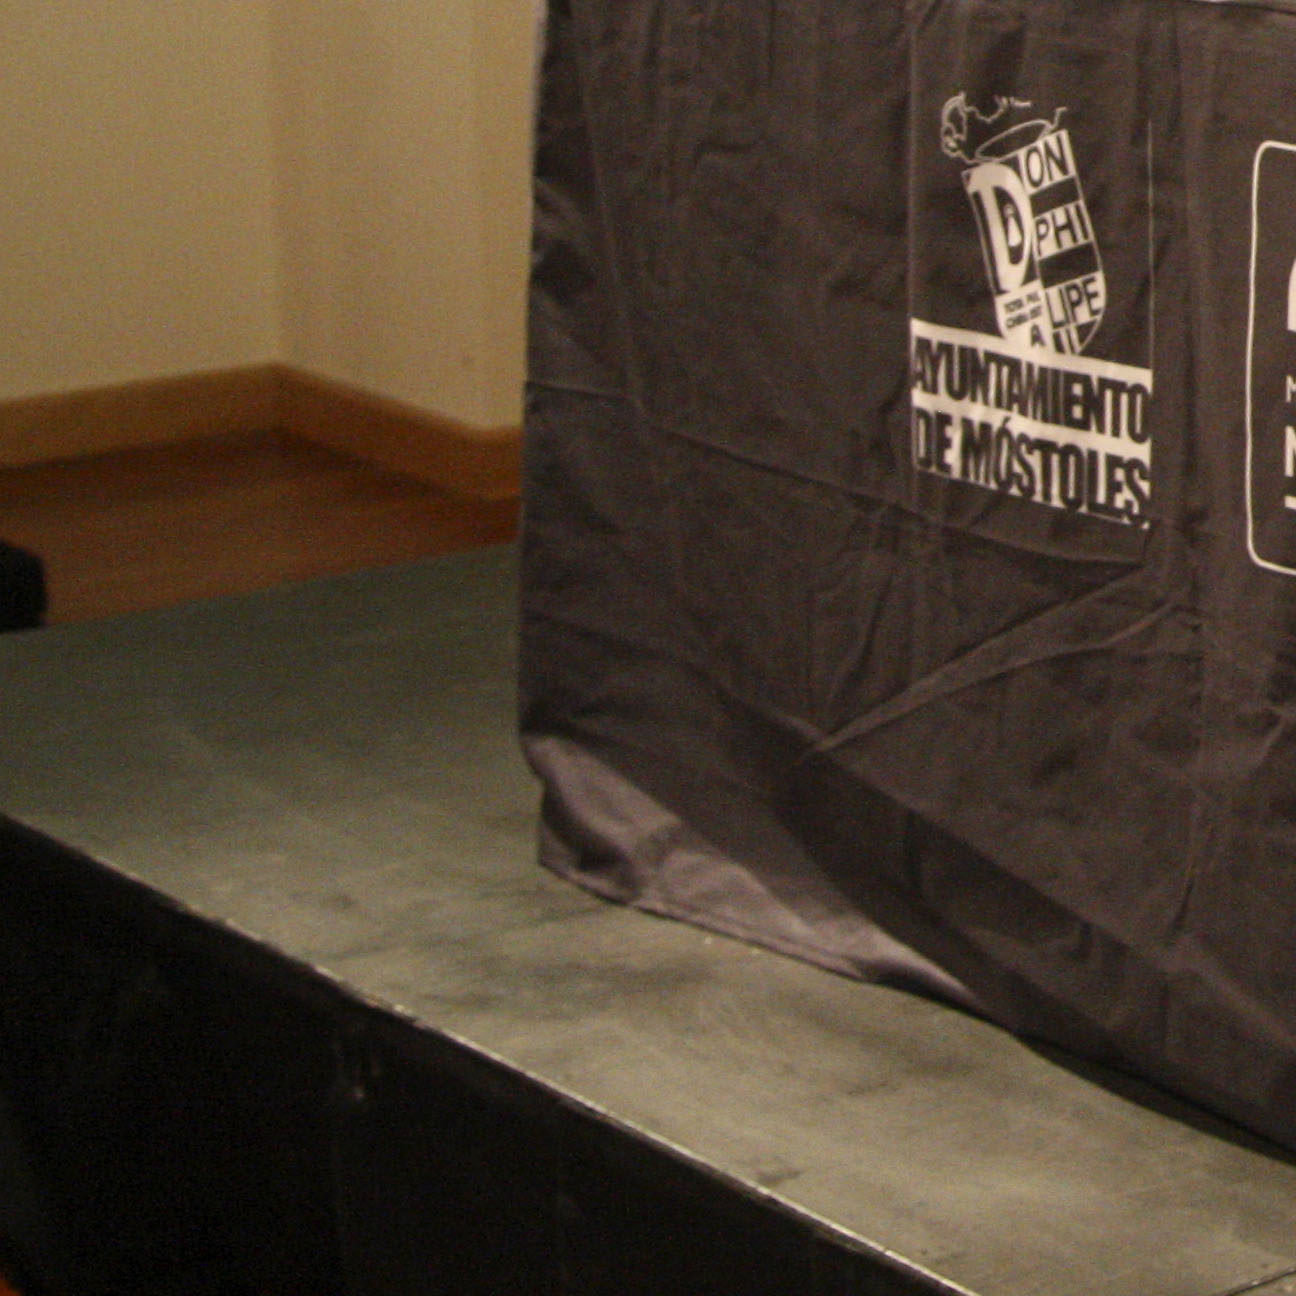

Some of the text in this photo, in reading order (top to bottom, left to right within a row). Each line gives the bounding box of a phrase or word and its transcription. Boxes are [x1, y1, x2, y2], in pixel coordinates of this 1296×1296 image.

[913, 336, 1151, 444] AYUNTAMIENTO
[915, 407, 1151, 530] DE MÓSTOLES
